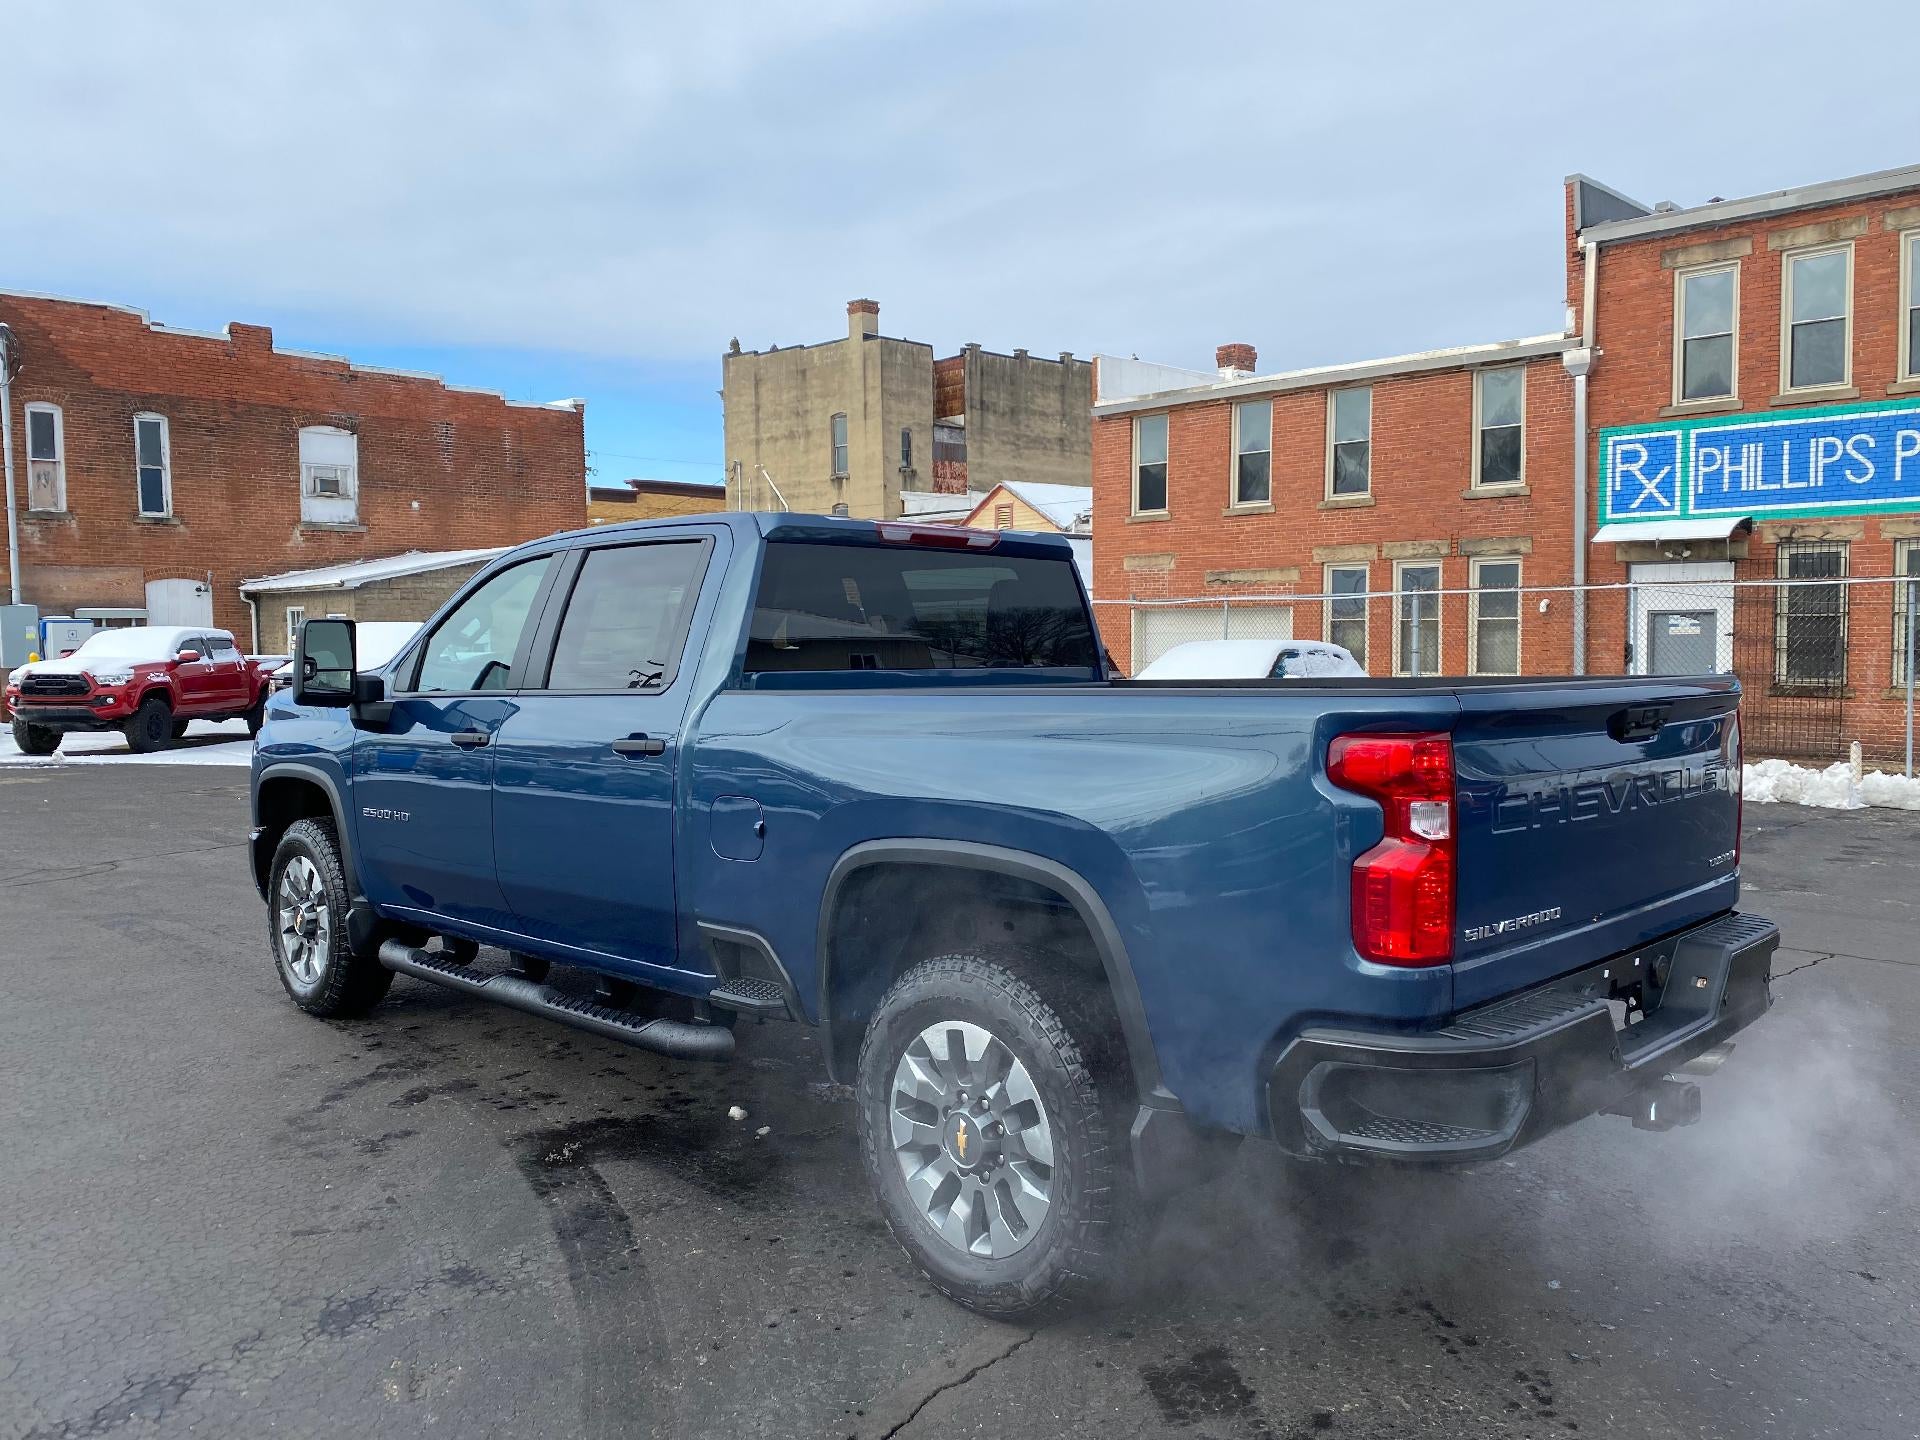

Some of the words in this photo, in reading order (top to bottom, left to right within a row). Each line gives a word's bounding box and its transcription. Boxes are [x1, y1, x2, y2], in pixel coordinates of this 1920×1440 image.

[1697, 433, 1876, 494] PHILLIPS
[362, 807, 391, 819] 2500
[393, 810, 409, 822] HD
[1464, 906, 1561, 942] SILVERADO
